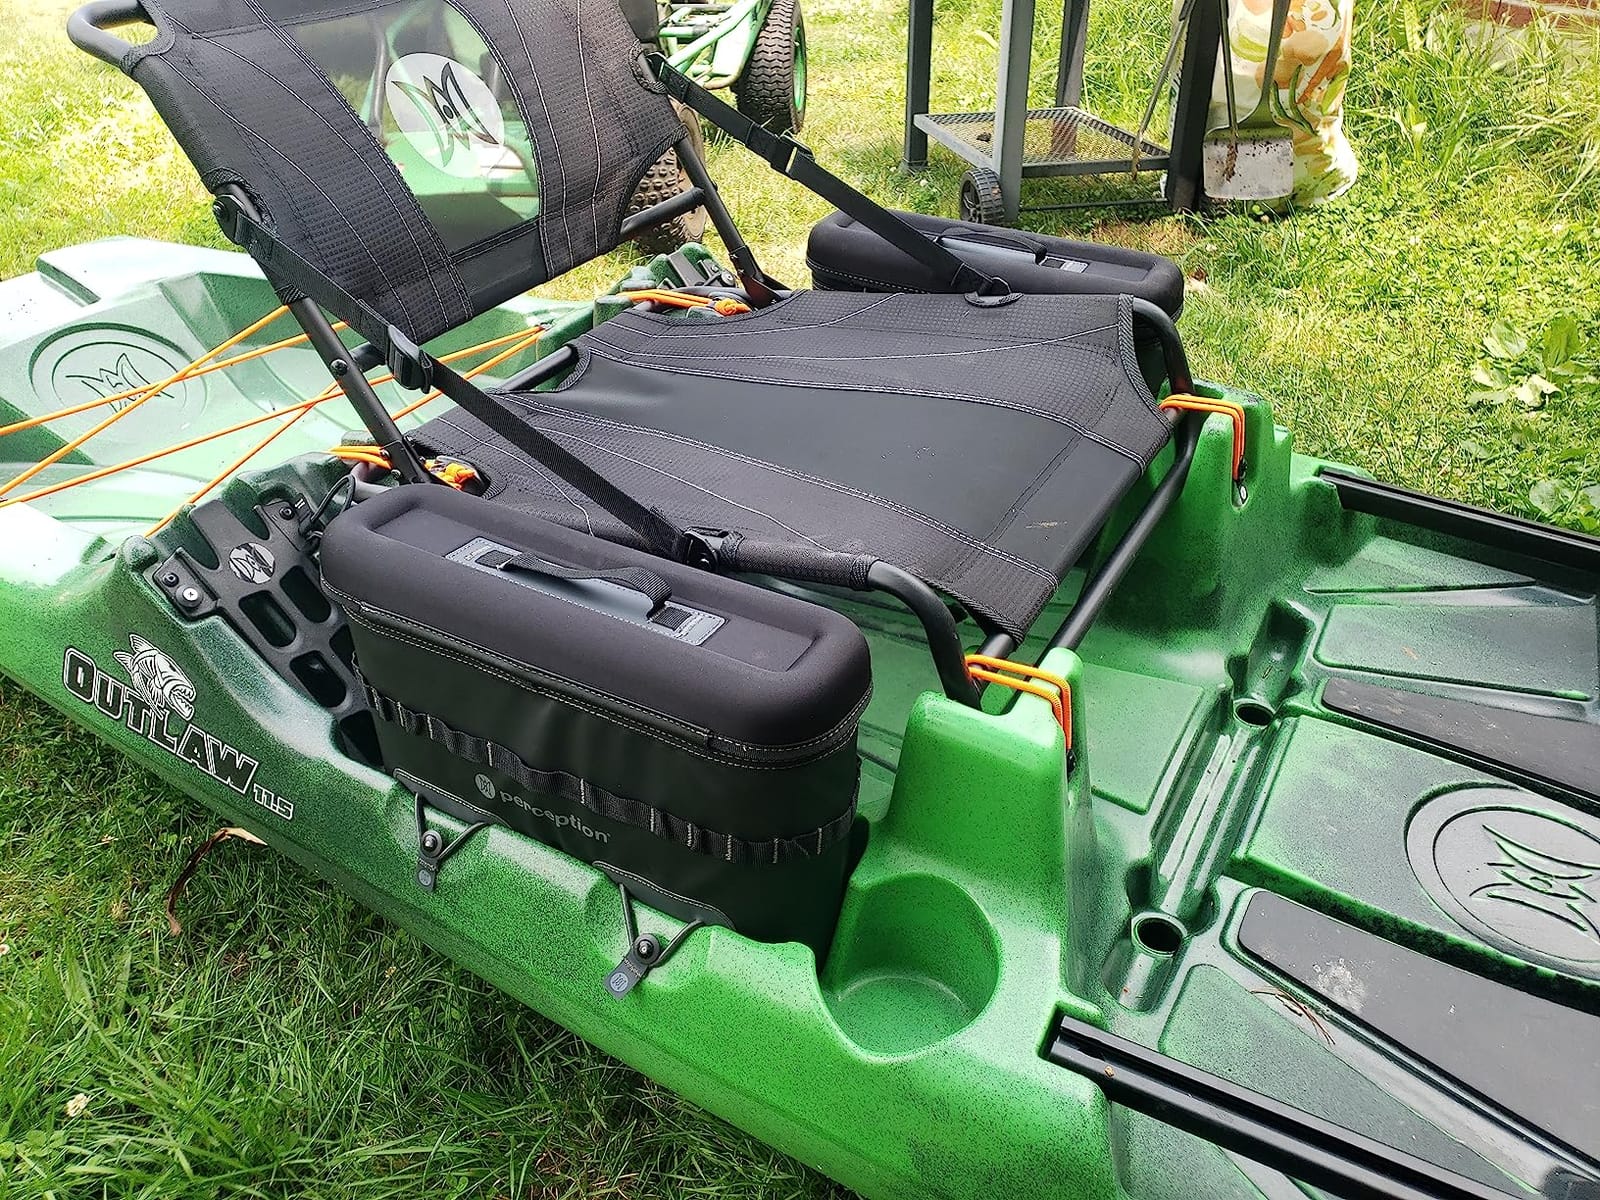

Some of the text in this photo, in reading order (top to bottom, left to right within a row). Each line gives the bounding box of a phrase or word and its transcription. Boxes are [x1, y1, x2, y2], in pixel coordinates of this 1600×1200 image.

[63, 647, 294, 820] OUTLAW 11.5
[499, 790, 609, 844] perception
